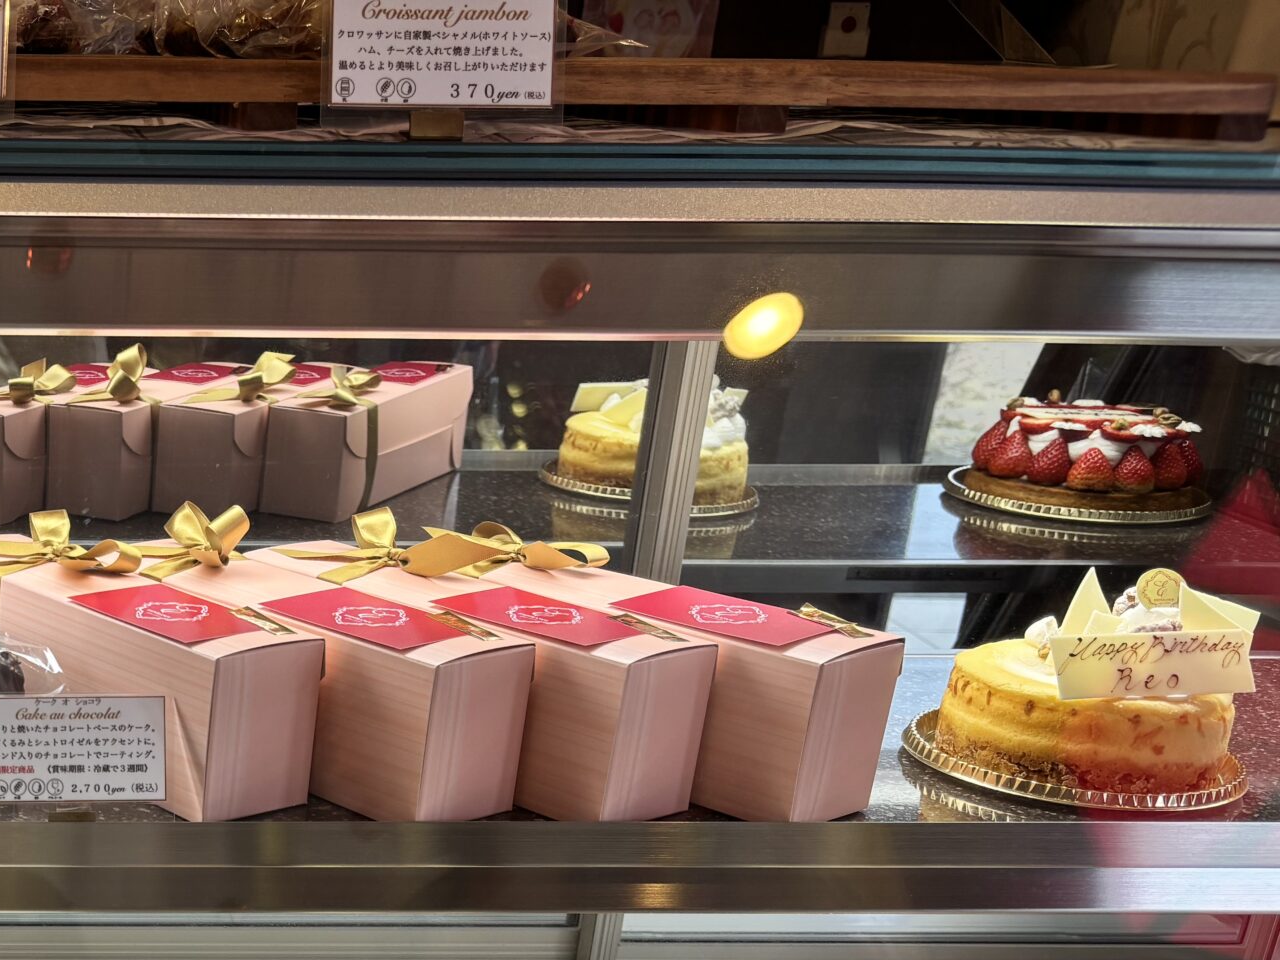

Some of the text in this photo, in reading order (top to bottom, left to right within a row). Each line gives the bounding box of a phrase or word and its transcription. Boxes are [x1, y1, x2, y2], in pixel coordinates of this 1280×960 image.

[361, 0, 532, 28] Croissant jambon
[1139, 634, 1245, 670] Birthday
[1110, 667, 1180, 693] Reo
[15, 707, 122, 720] Cake au chocolat
